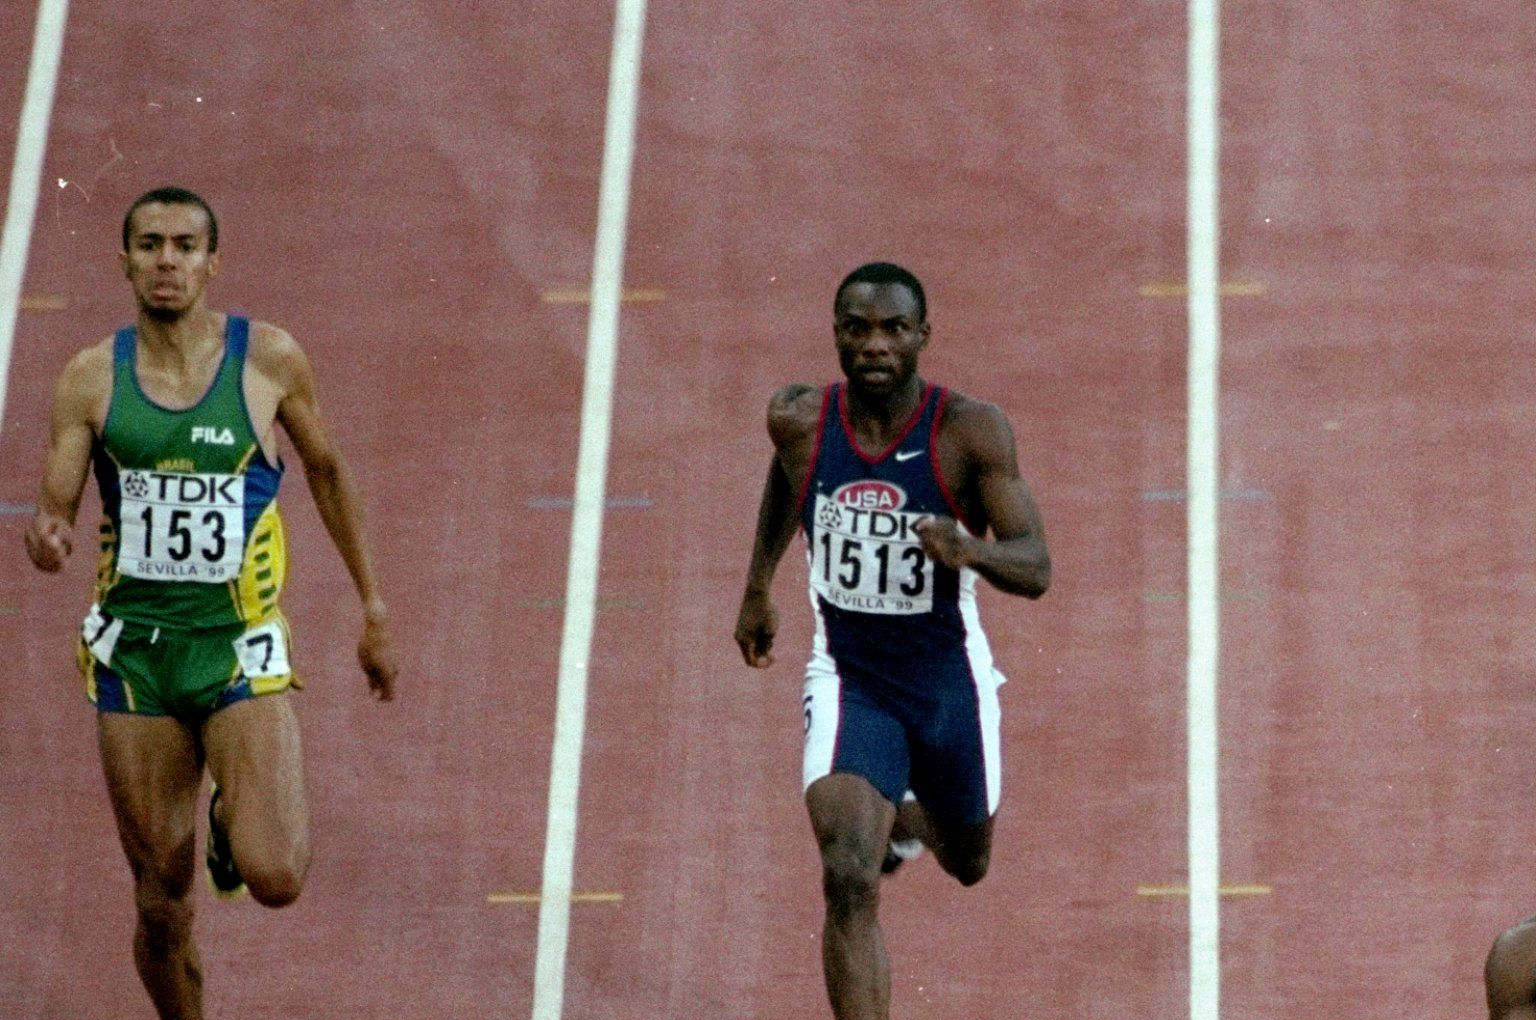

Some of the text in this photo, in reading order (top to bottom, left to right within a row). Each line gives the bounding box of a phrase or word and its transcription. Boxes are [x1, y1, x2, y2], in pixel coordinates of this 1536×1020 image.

[191, 426, 235, 446] FILA
[150, 474, 237, 504] TDK
[845, 490, 893, 509] USA
[141, 506, 226, 563] 153
[844, 506, 925, 540] TDK
[137, 561, 198, 576] SEVILLA
[821, 532, 925, 597] 1513
[827, 588, 885, 609] SEVILLA
[246, 632, 273, 672] 7
